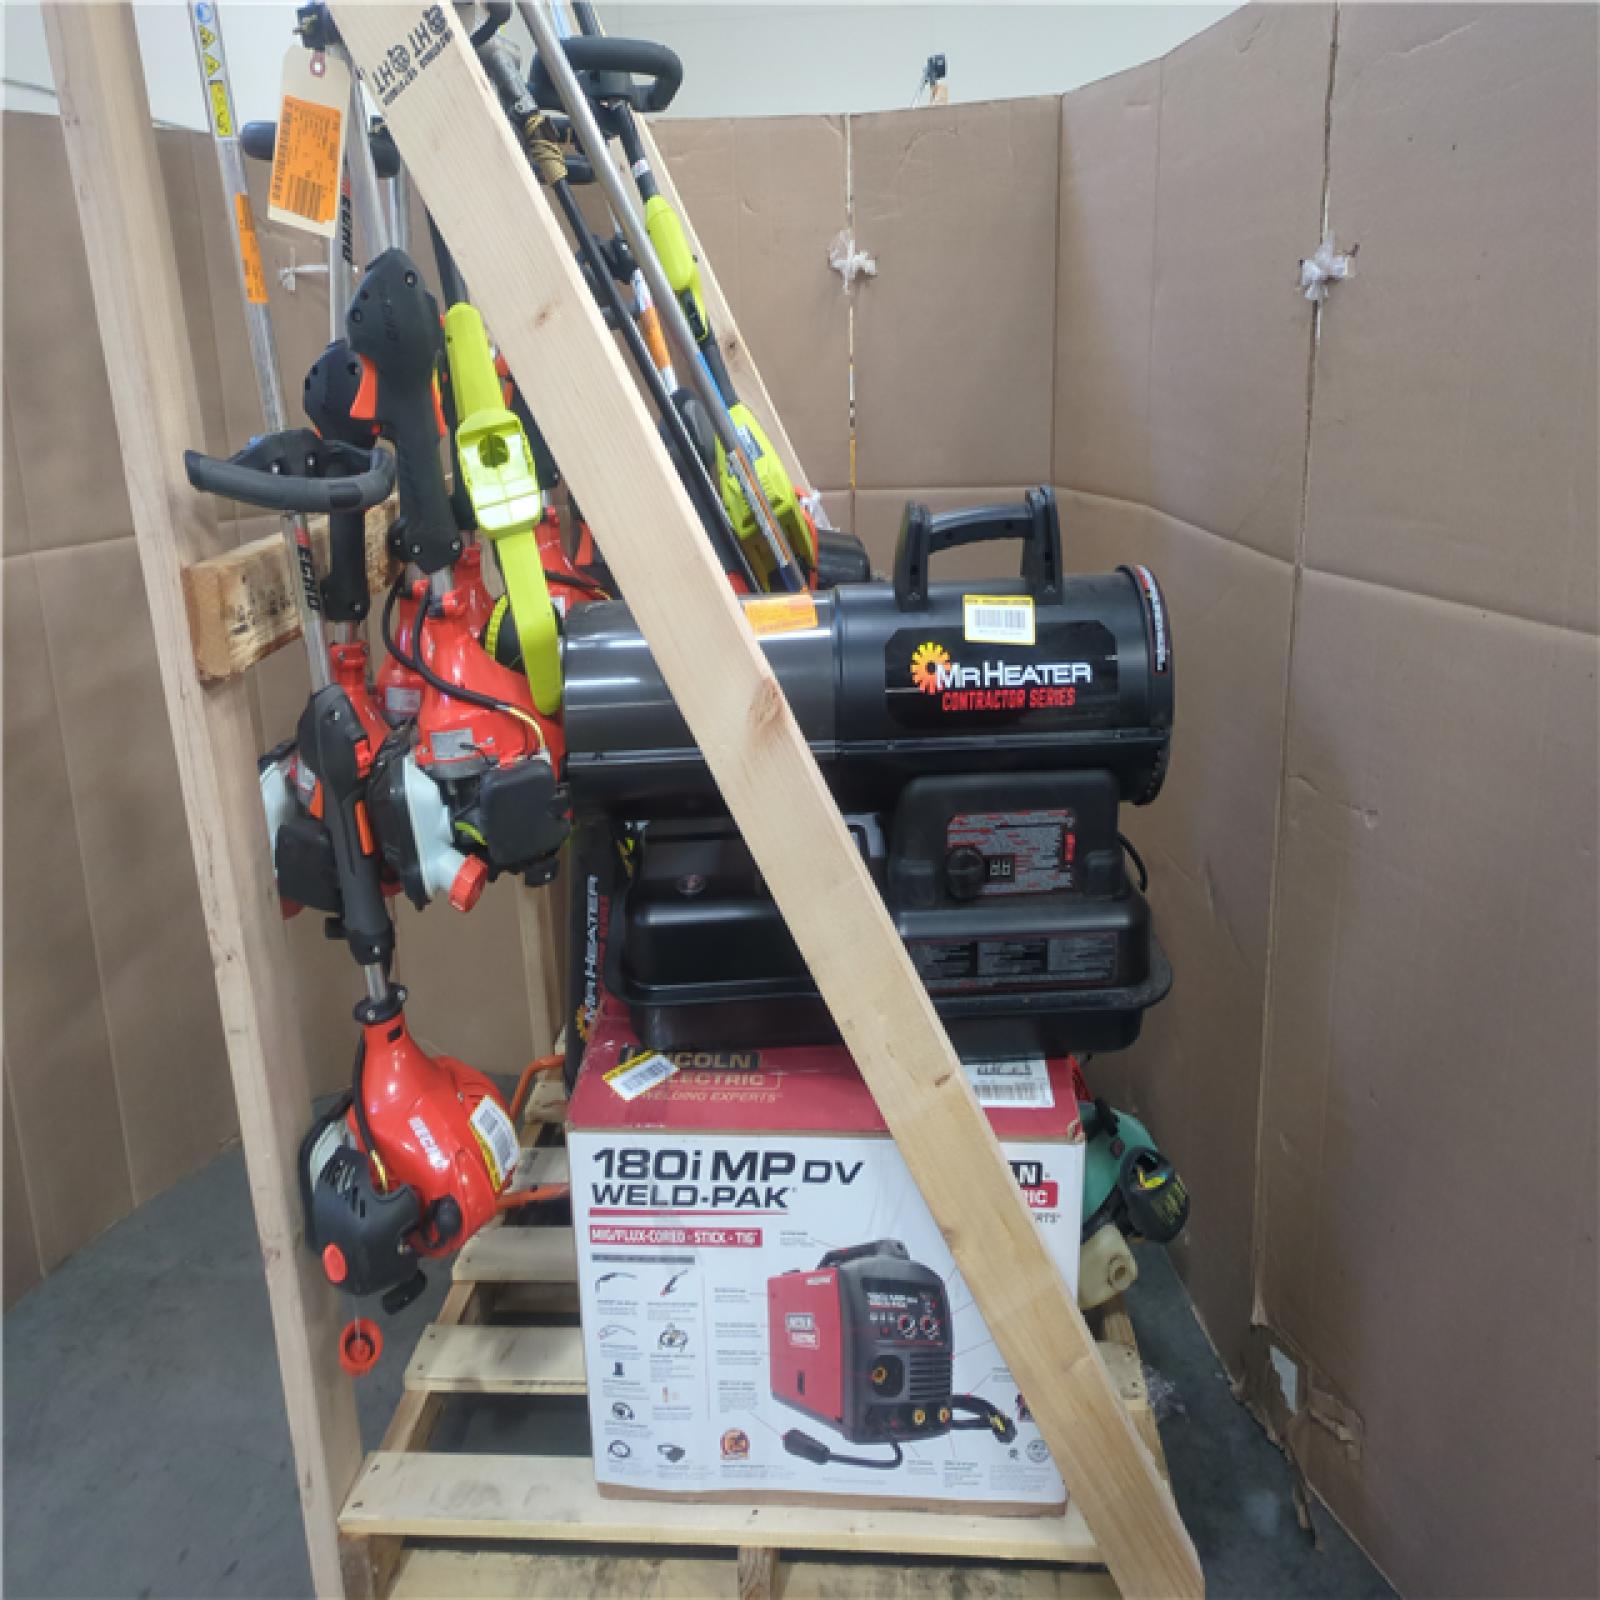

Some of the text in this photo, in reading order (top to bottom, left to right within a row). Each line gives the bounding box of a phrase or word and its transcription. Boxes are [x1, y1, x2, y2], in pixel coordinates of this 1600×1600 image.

[983, 660, 1094, 688] HEATER
[942, 686, 1076, 712] CONTRACTOR SERIES
[592, 1147, 866, 1185] 180i MP DV
[591, 1183, 790, 1208] WELD-PAK
